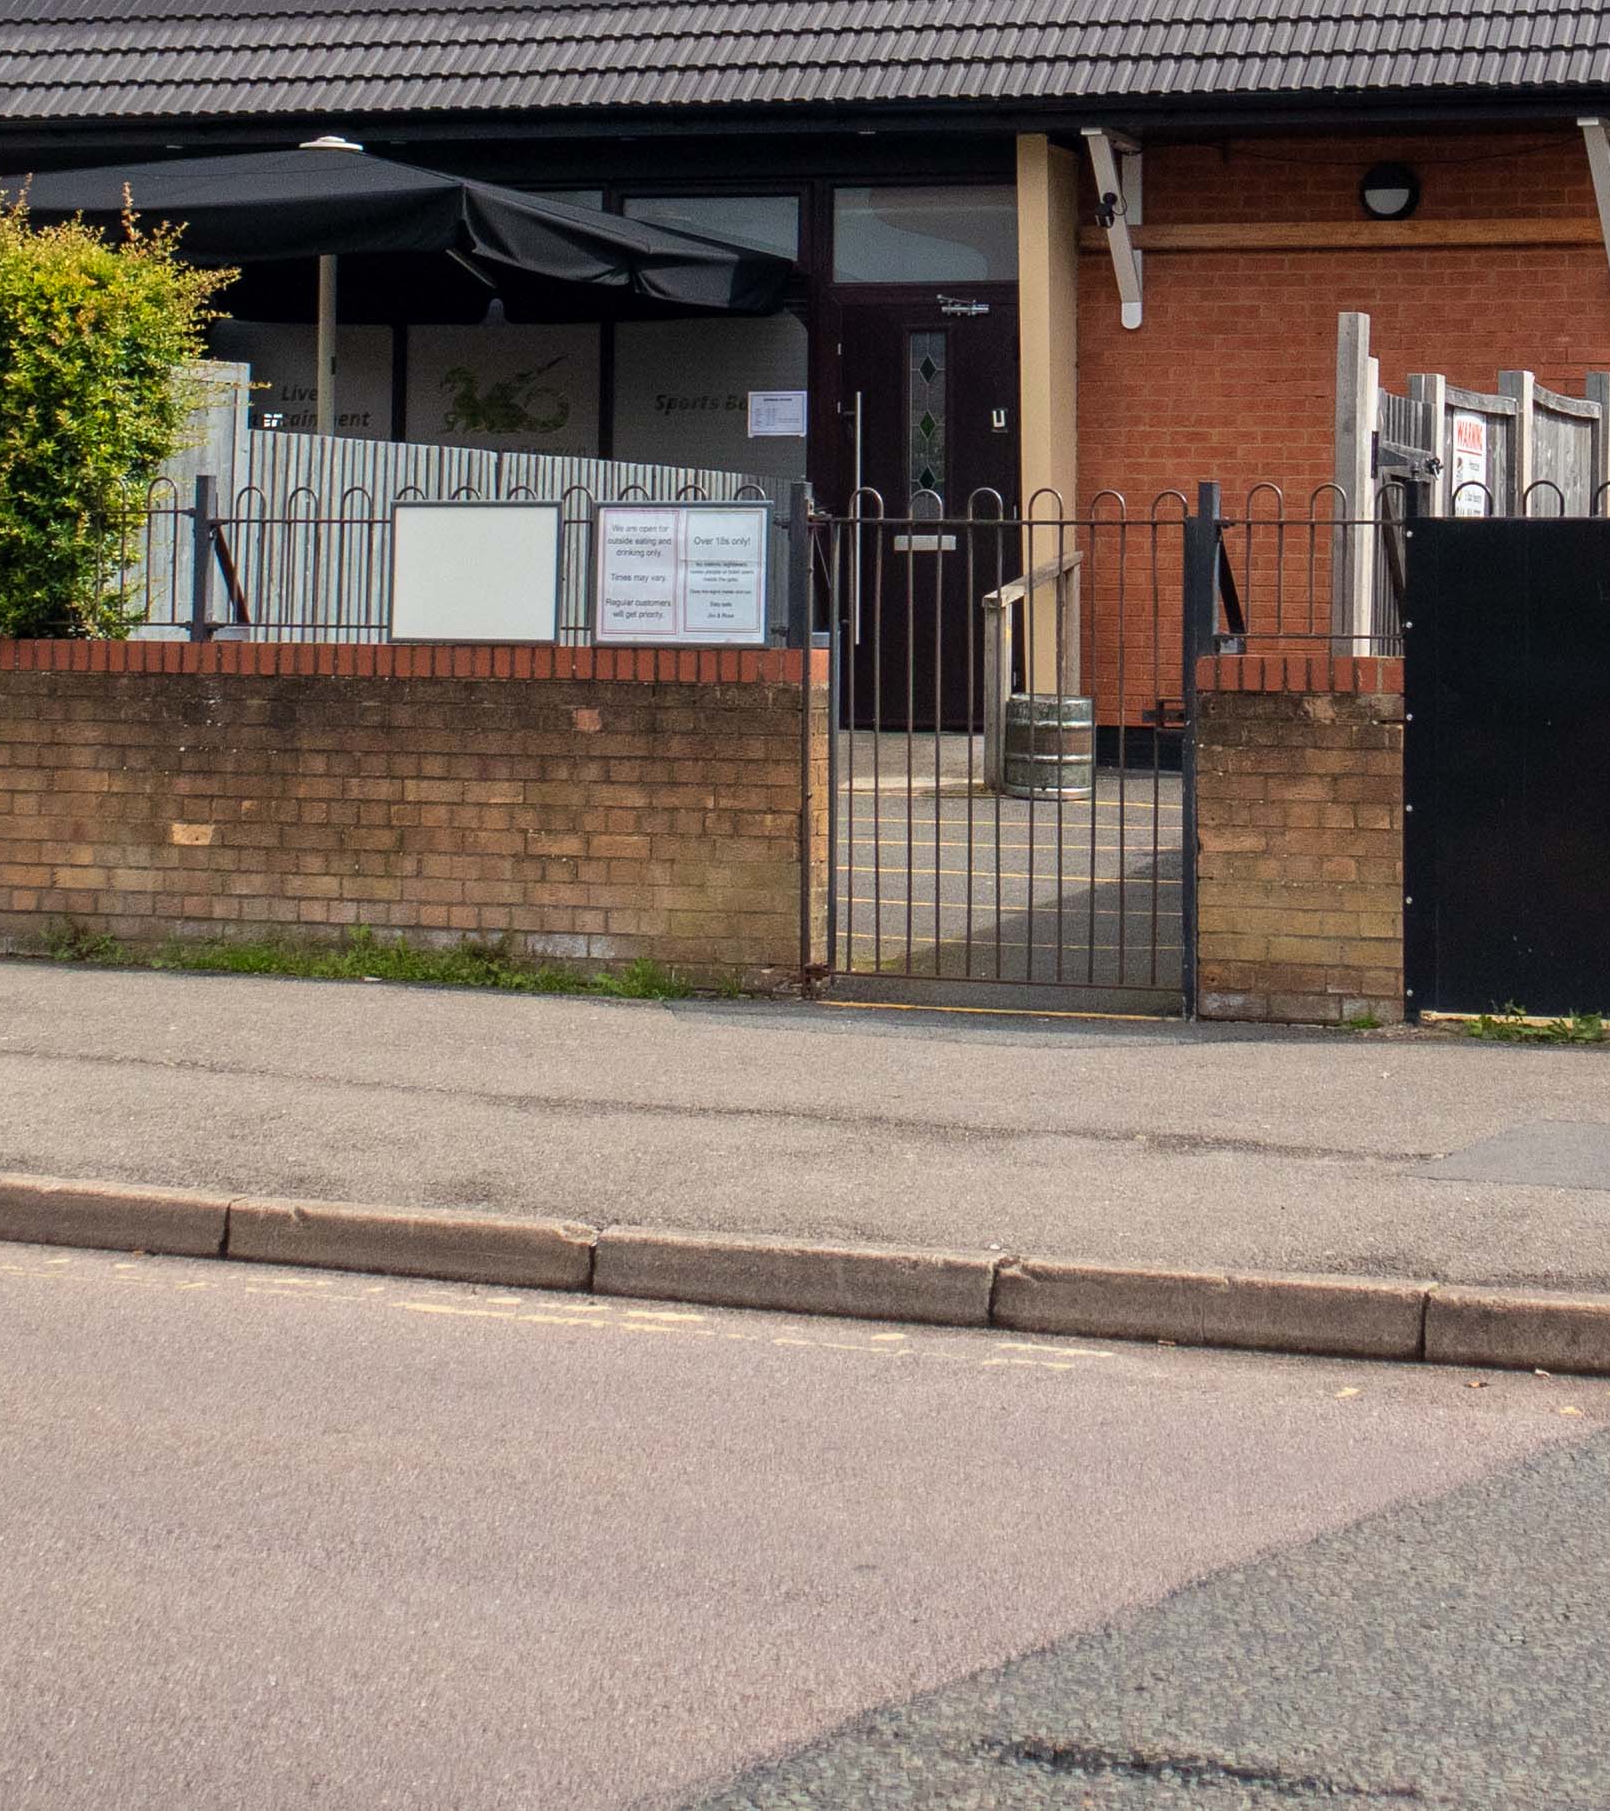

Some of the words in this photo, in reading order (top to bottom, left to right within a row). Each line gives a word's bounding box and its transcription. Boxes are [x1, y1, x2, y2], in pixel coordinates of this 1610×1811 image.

[655, 394, 720, 415] Sports
[639, 526, 657, 534] open
[608, 537, 633, 545] outside
[635, 537, 657, 546] eating
[659, 537, 671, 545] and
[694, 536, 714, 546] Over
[611, 573, 631, 582] Times
[634, 574, 649, 583] may
[606, 598, 633, 607] Regular
[635, 599, 671, 607] customers
